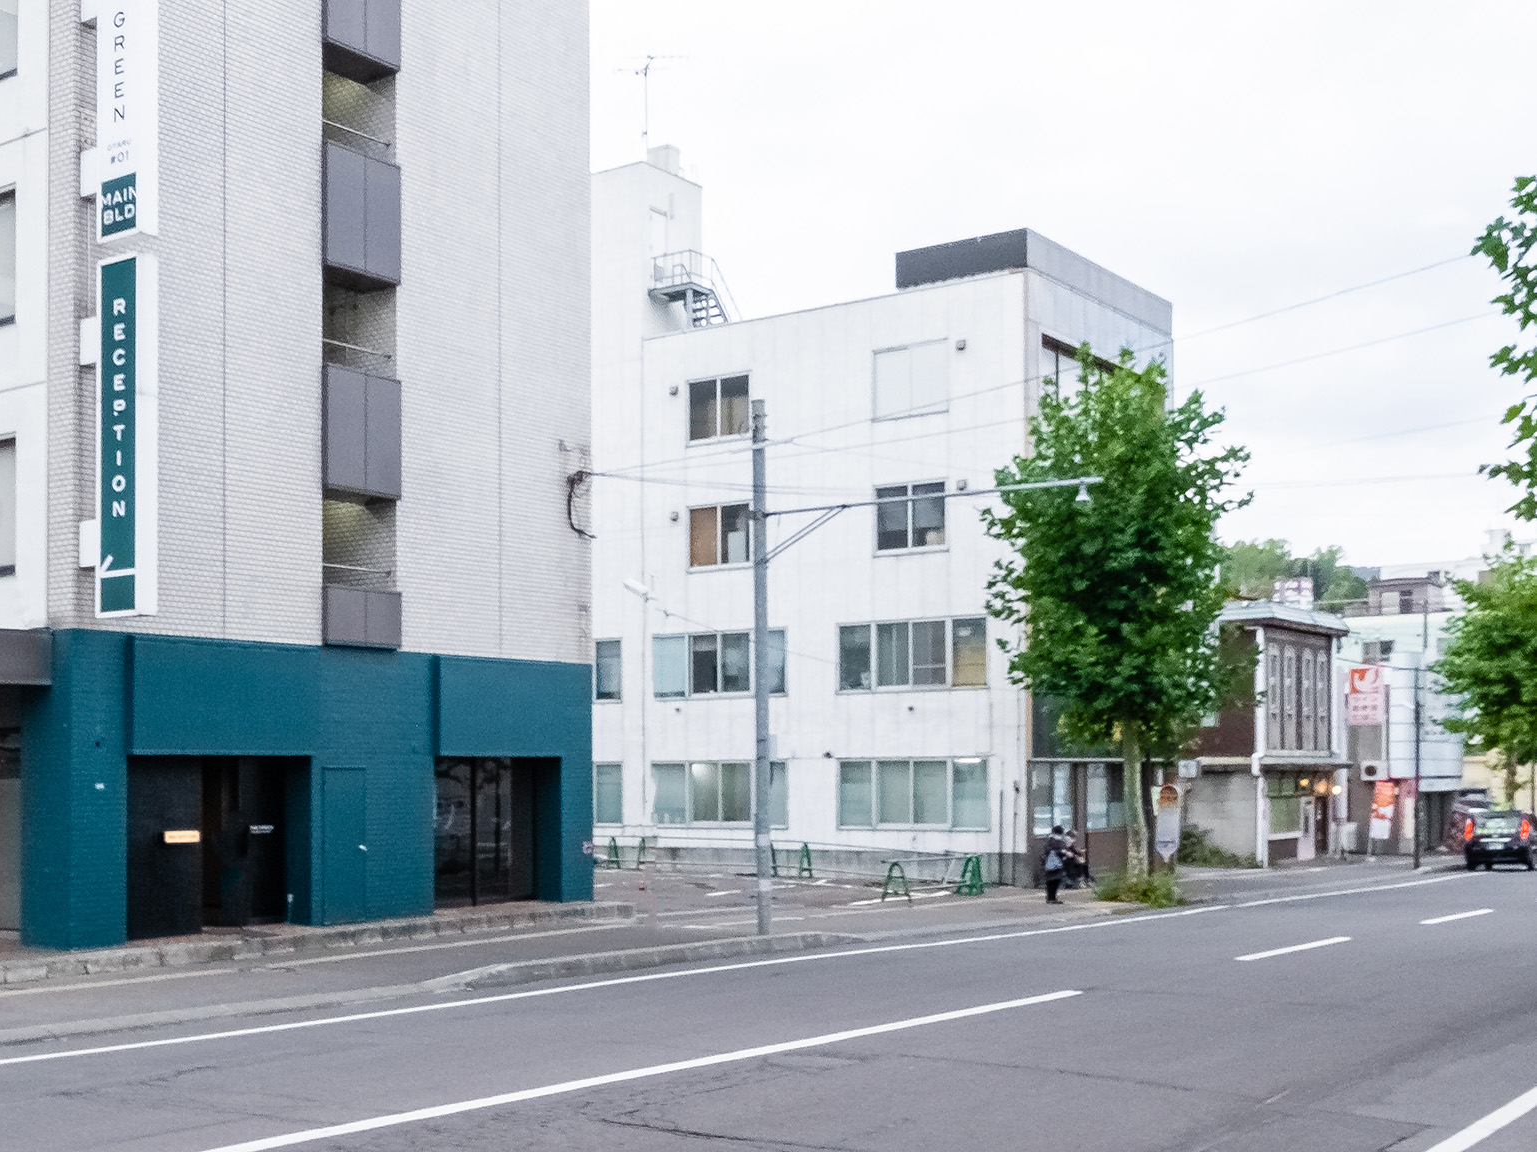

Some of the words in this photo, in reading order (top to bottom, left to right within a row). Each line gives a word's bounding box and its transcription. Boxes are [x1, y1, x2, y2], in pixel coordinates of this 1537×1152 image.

[113, 11, 125, 123] GREEN
[110, 150, 129, 164] #01
[101, 185, 137, 206] MAIN
[103, 203, 135, 226] BLD
[111, 297, 126, 518] RECEPTION
